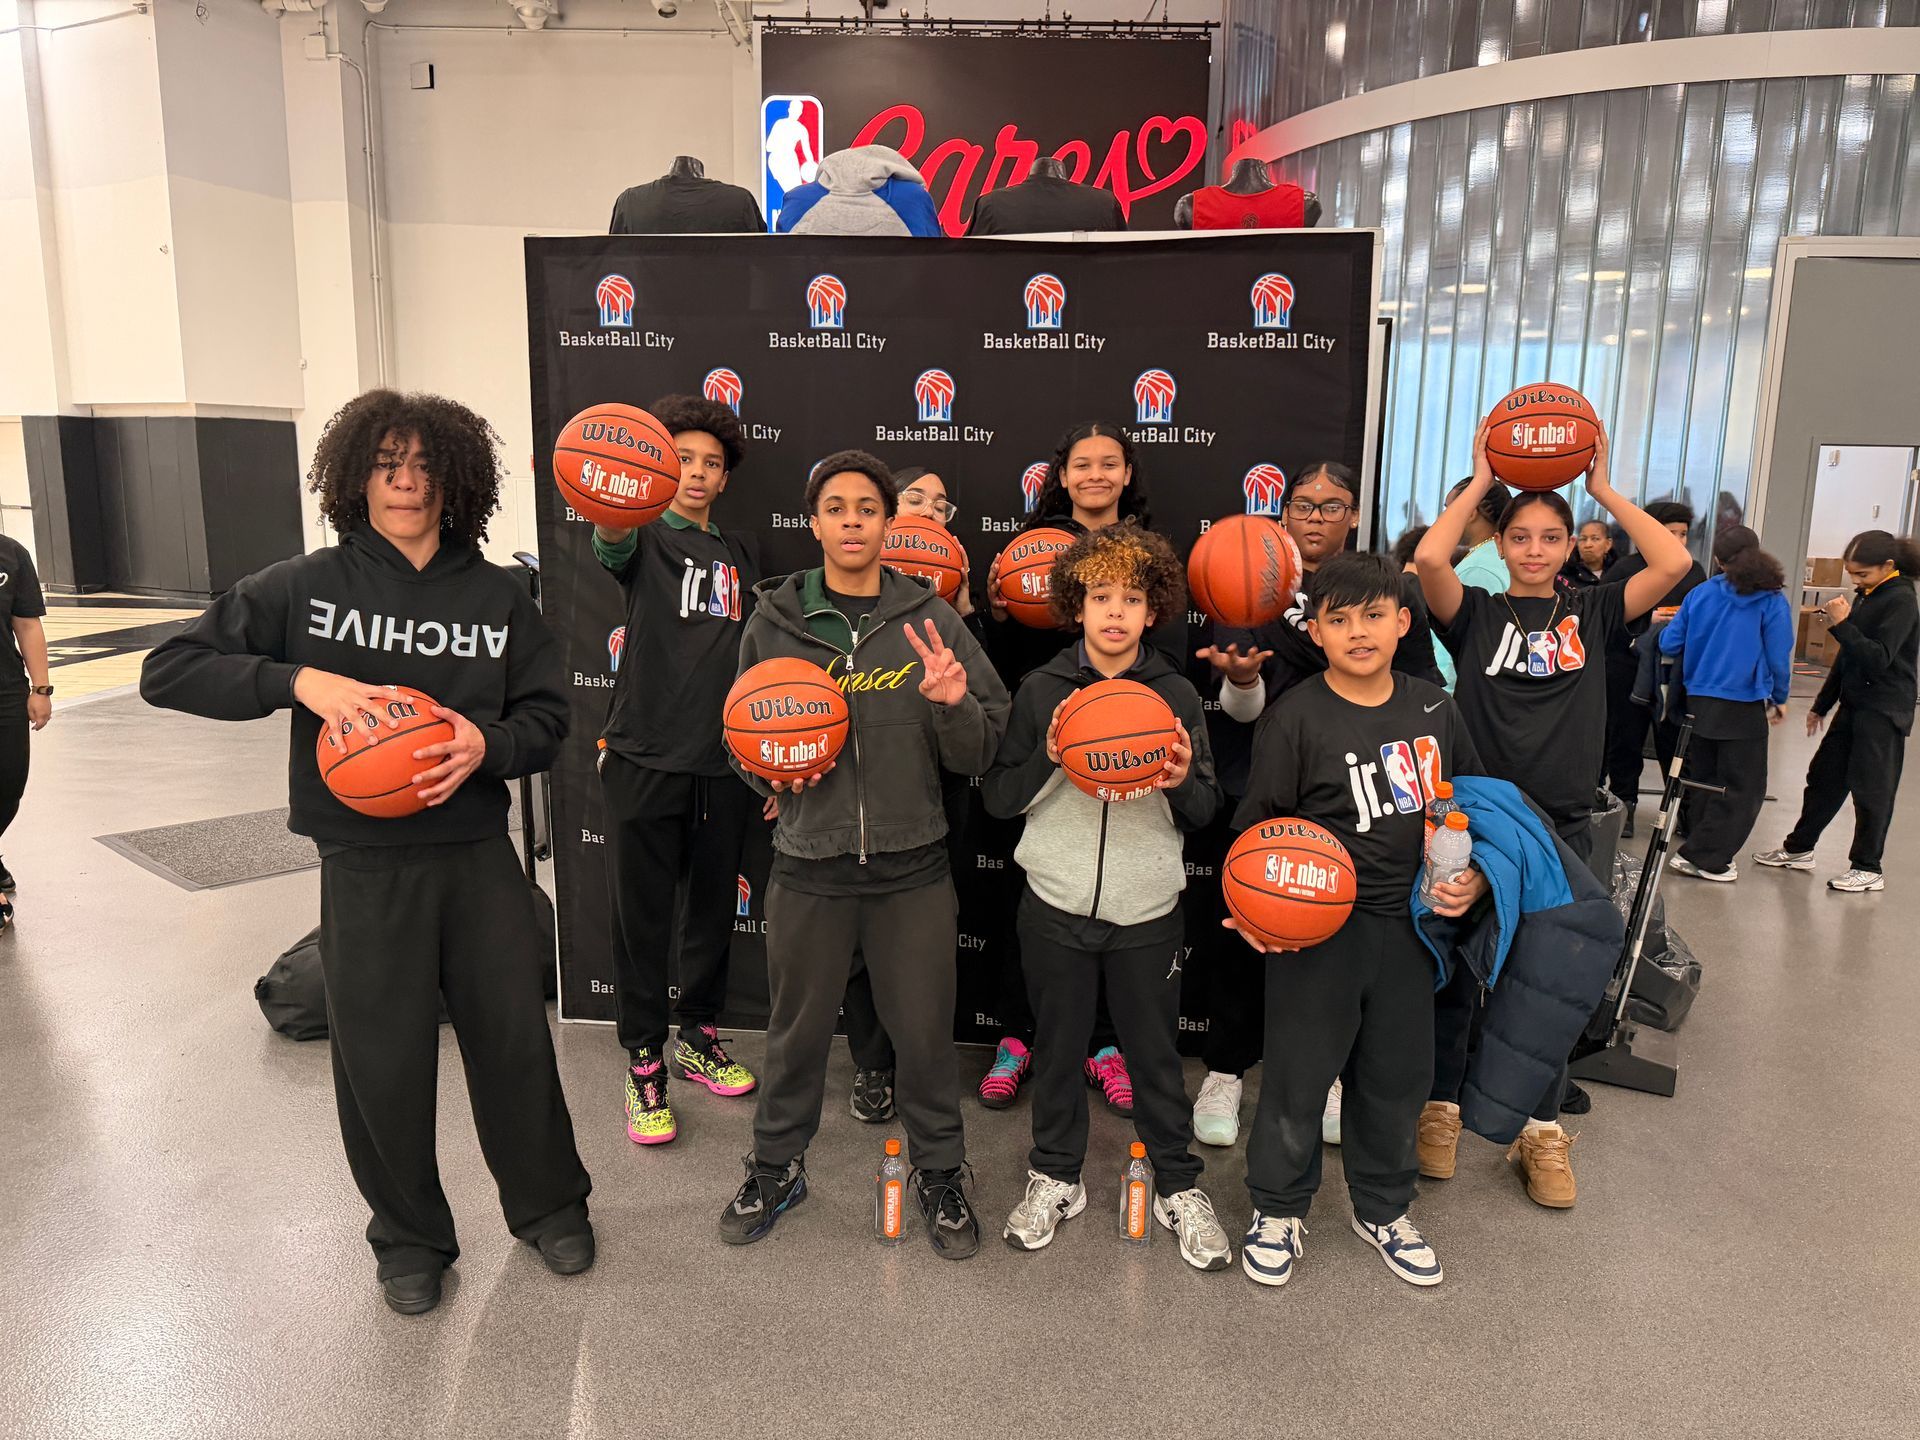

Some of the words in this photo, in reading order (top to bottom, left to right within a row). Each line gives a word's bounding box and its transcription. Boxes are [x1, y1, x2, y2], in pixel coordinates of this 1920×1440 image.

[559, 331, 641, 347] BasketBall
[645, 333, 675, 351] City
[768, 332, 852, 349] BasketBall
[856, 333, 887, 352] City
[983, 332, 1069, 349] BasketBall
[1074, 333, 1106, 352] City
[1207, 331, 1298, 349] BasketBall
[1303, 333, 1336, 352] City
[1505, 389, 1583, 412] Wilson
[581, 423, 663, 464] Wilson
[752, 425, 782, 443] City
[875, 426, 959, 441] BasketBall
[964, 427, 994, 445] City
[1122, 428, 1179, 443] ketBall
[1184, 428, 1216, 446] City
[884, 533, 950, 559] Wilson
[679, 557, 708, 618] jr.
[710, 602, 722, 613] NBA
[308, 598, 509, 658] ARCHIVE
[1187, 610, 1208, 627] ity
[1531, 661, 1545, 674] NBA
[749, 696, 832, 723] Wilson
[1085, 745, 1167, 772] Wilson
[1344, 752, 1395, 833] jr.
[1398, 795, 1413, 809] NBA
[1258, 823, 1345, 854] Wilson
[958, 934, 986, 951] City
[886, 1186, 895, 1233] GATORADE
[1131, 1186, 1140, 1233] GATORADE
